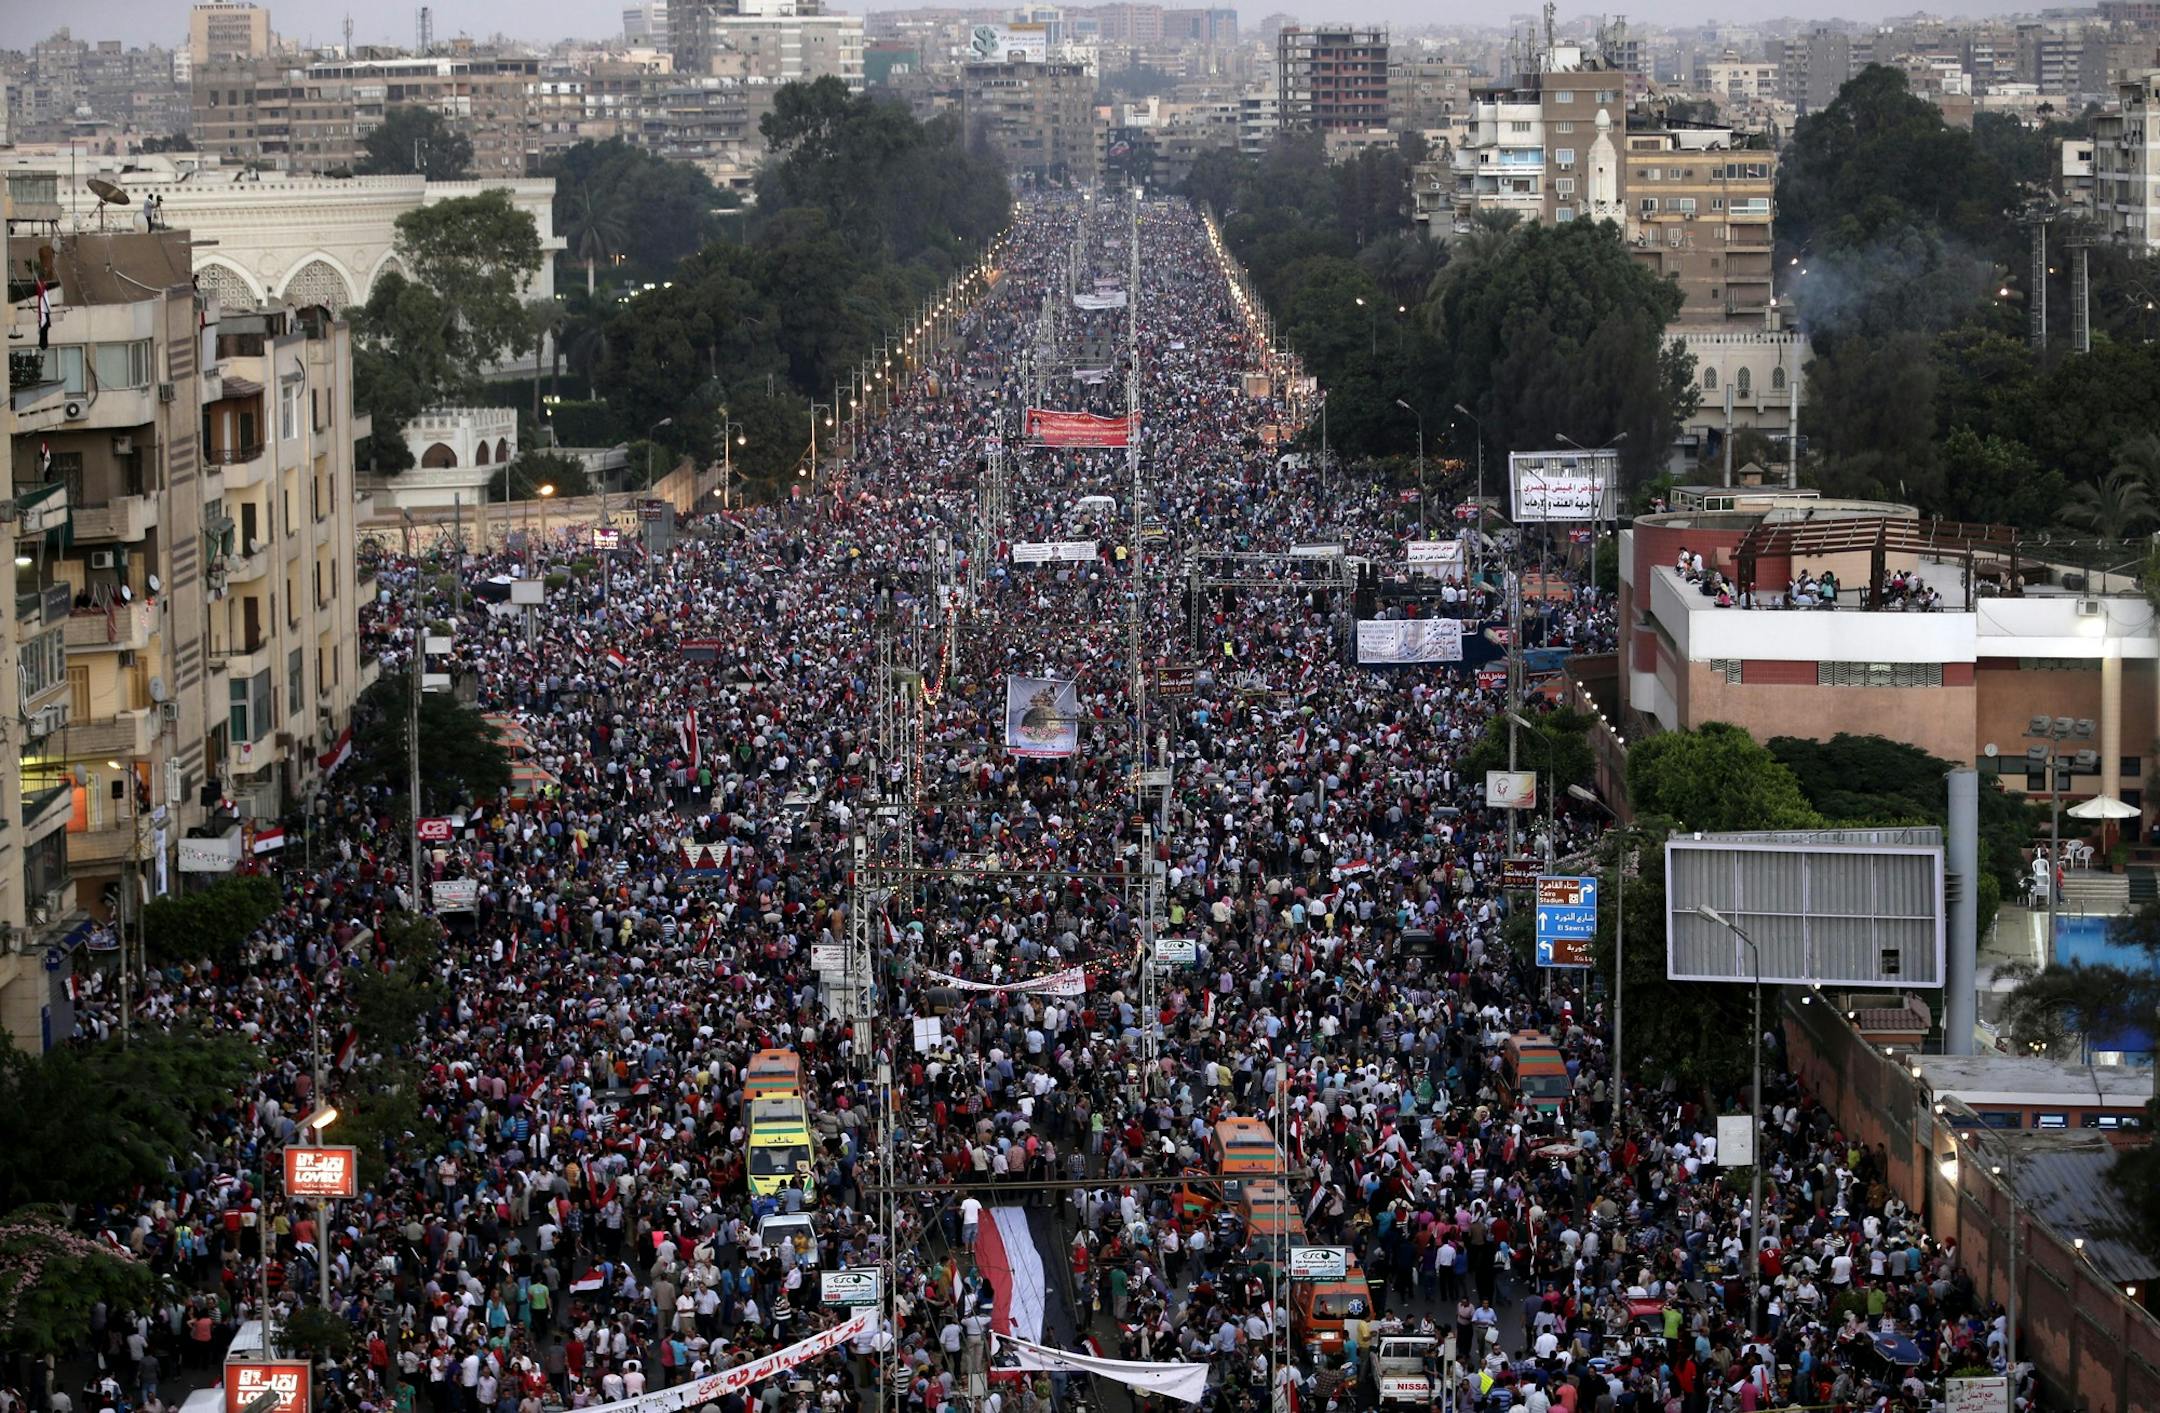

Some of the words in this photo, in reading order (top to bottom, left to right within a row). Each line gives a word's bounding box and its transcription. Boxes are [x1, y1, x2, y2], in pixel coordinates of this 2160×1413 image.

[1540, 881, 1563, 890] القاهرة
[1564, 881, 1579, 890] ستاد
[1554, 912, 1576, 922] الثورة
[1577, 912, 1594, 923] شارع
[295, 1171, 344, 1183] LOVELY
[237, 1391, 296, 1405] LOLY
